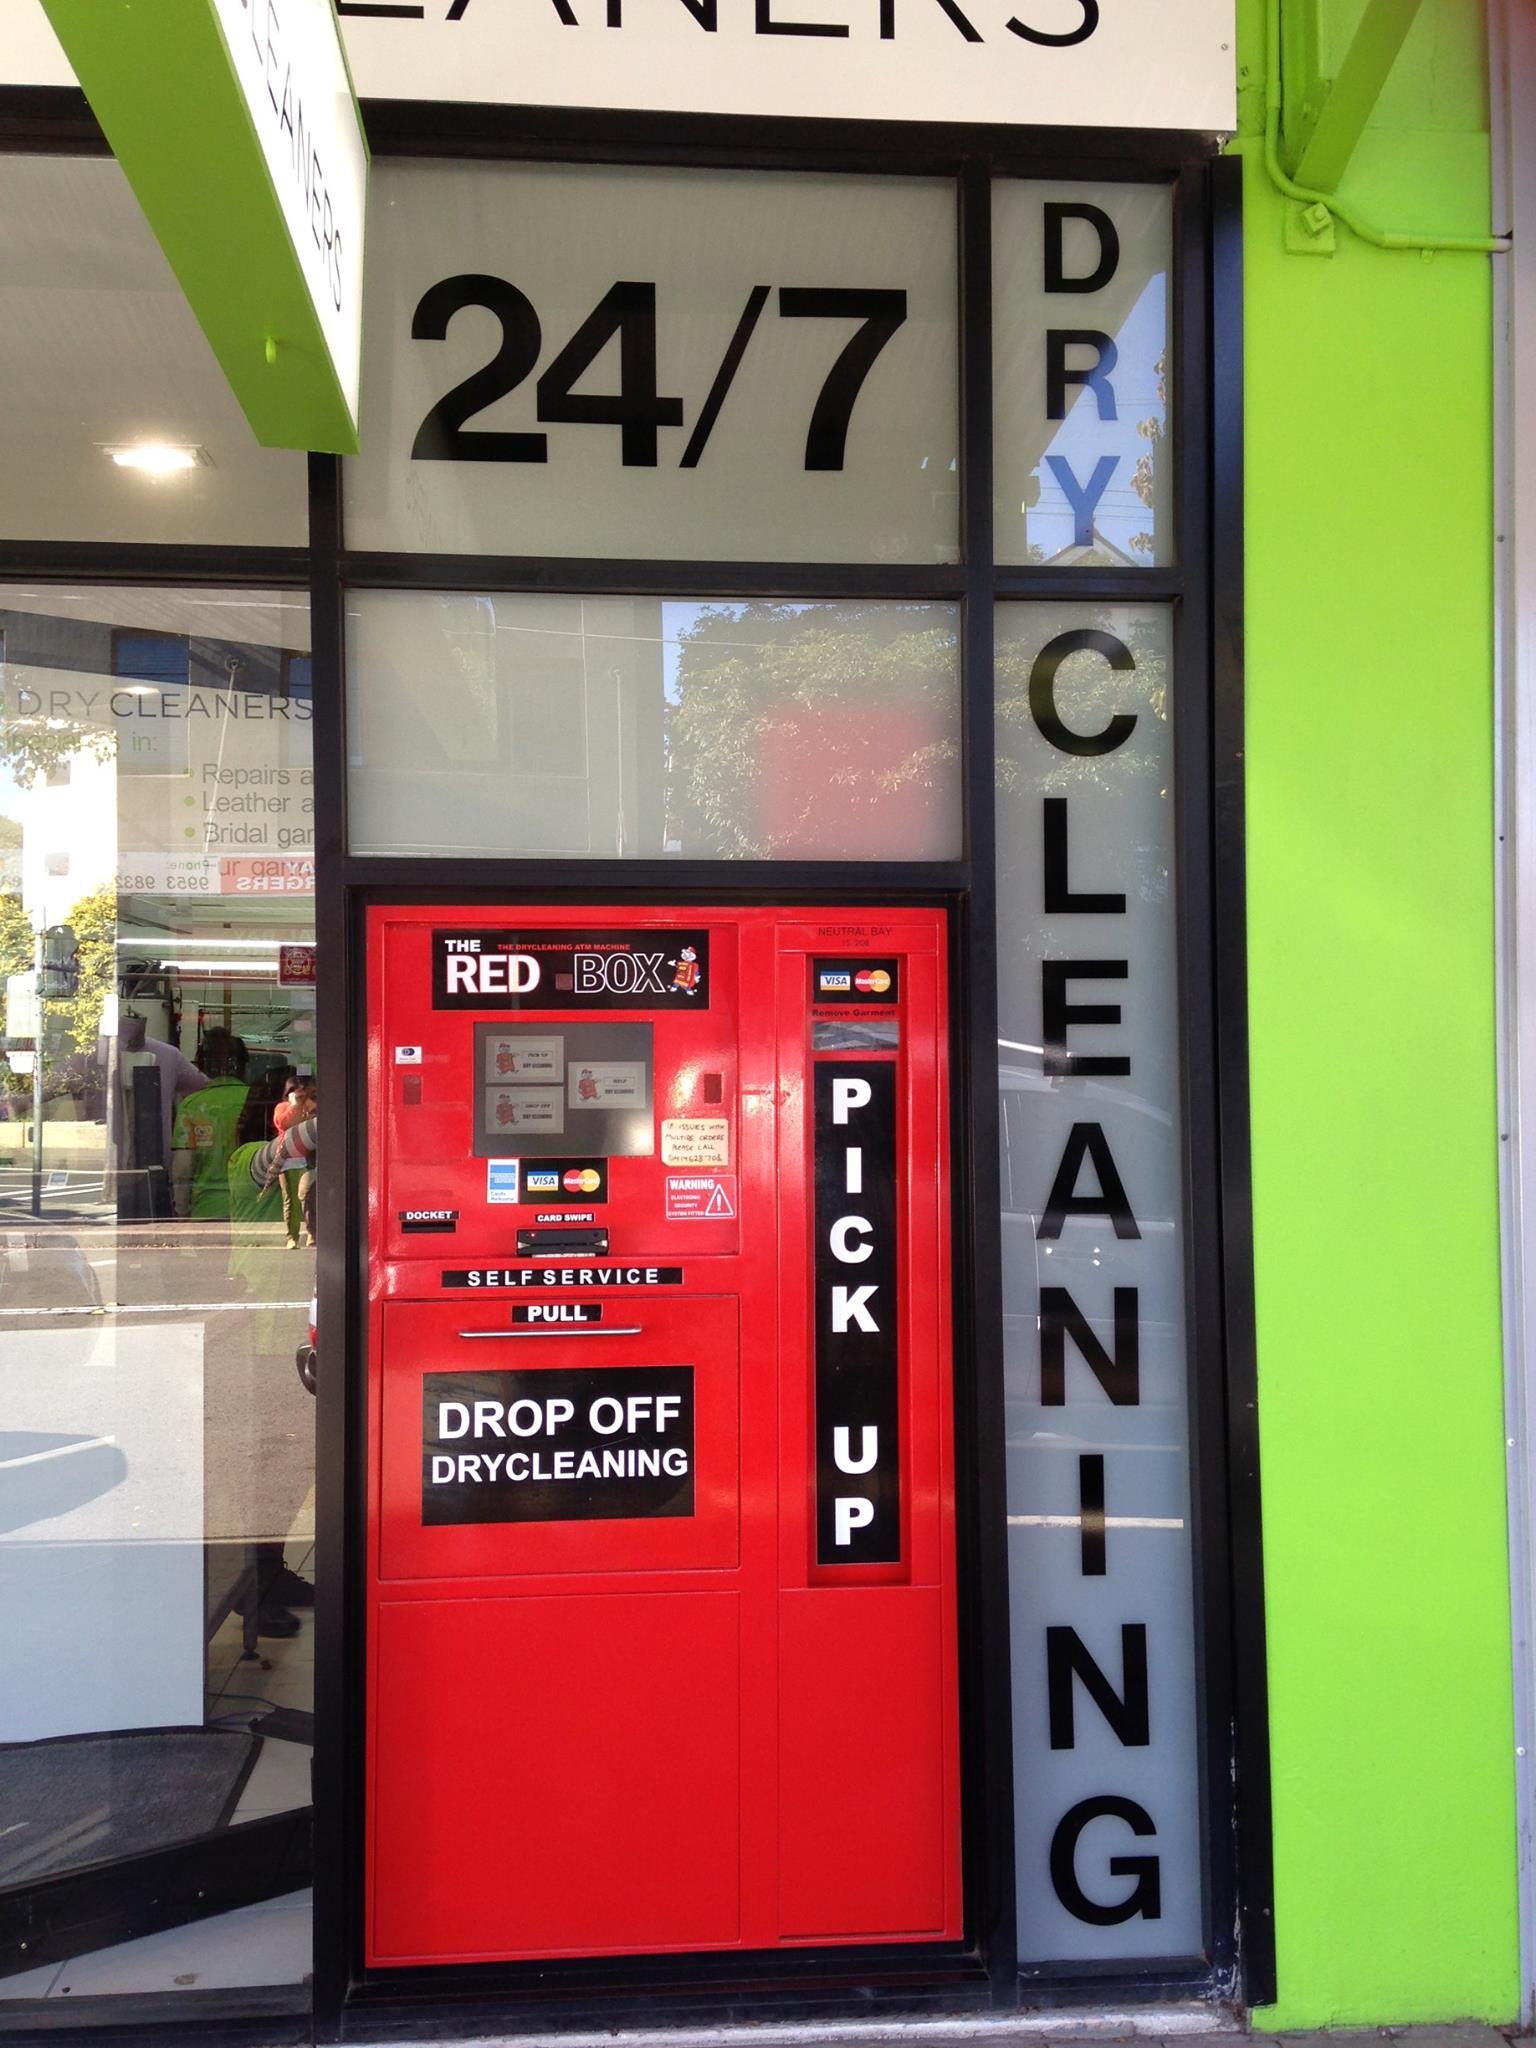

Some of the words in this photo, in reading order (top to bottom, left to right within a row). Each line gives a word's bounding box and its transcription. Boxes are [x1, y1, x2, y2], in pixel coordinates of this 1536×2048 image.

[241, 0, 343, 312] LEANERS
[411, 273, 908, 472] 24/7
[1044, 202, 1120, 547] DRY
[18, 690, 100, 716] DRY
[110, 691, 313, 721] CLEANERS
[203, 763, 290, 790] Repairs
[203, 791, 291, 813] Leather
[203, 822, 268, 843] Bridal
[818, 926, 867, 936] NEUTRAL
[871, 926, 893, 936] BAY
[444, 939, 481, 953] THE
[497, 943, 514, 951] THE
[515, 943, 573, 951] DRYCLEANING
[574, 943, 592, 951] ATM
[593, 943, 631, 951] MACHINE
[446, 954, 541, 994] RED
[573, 953, 666, 994] BOX
[824, 976, 848, 985] VISA
[855, 977, 890, 985] MasterCard
[812, 1008, 850, 1017] Remove
[853, 1008, 896, 1017] Garment
[532, 1176, 556, 1185] VISA
[563, 1177, 600, 1185] MasterCard
[669, 1179, 714, 1190] WARNING
[406, 1210, 453, 1220] DOCKET
[829, 1078, 880, 1334] PICK
[537, 1214, 562, 1222] CARD
[564, 1213, 593, 1221] SWIPE
[467, 1270, 533, 1287] SELF
[543, 1268, 659, 1285] SERVICE
[1029, 628, 1162, 1927] CLEANING
[527, 1305, 588, 1323] PULL
[438, 1399, 575, 1440] DROP
[588, 1396, 682, 1435] OFF
[431, 1448, 689, 1485] DRYCLEANING
[833, 1425, 878, 1546] UP
